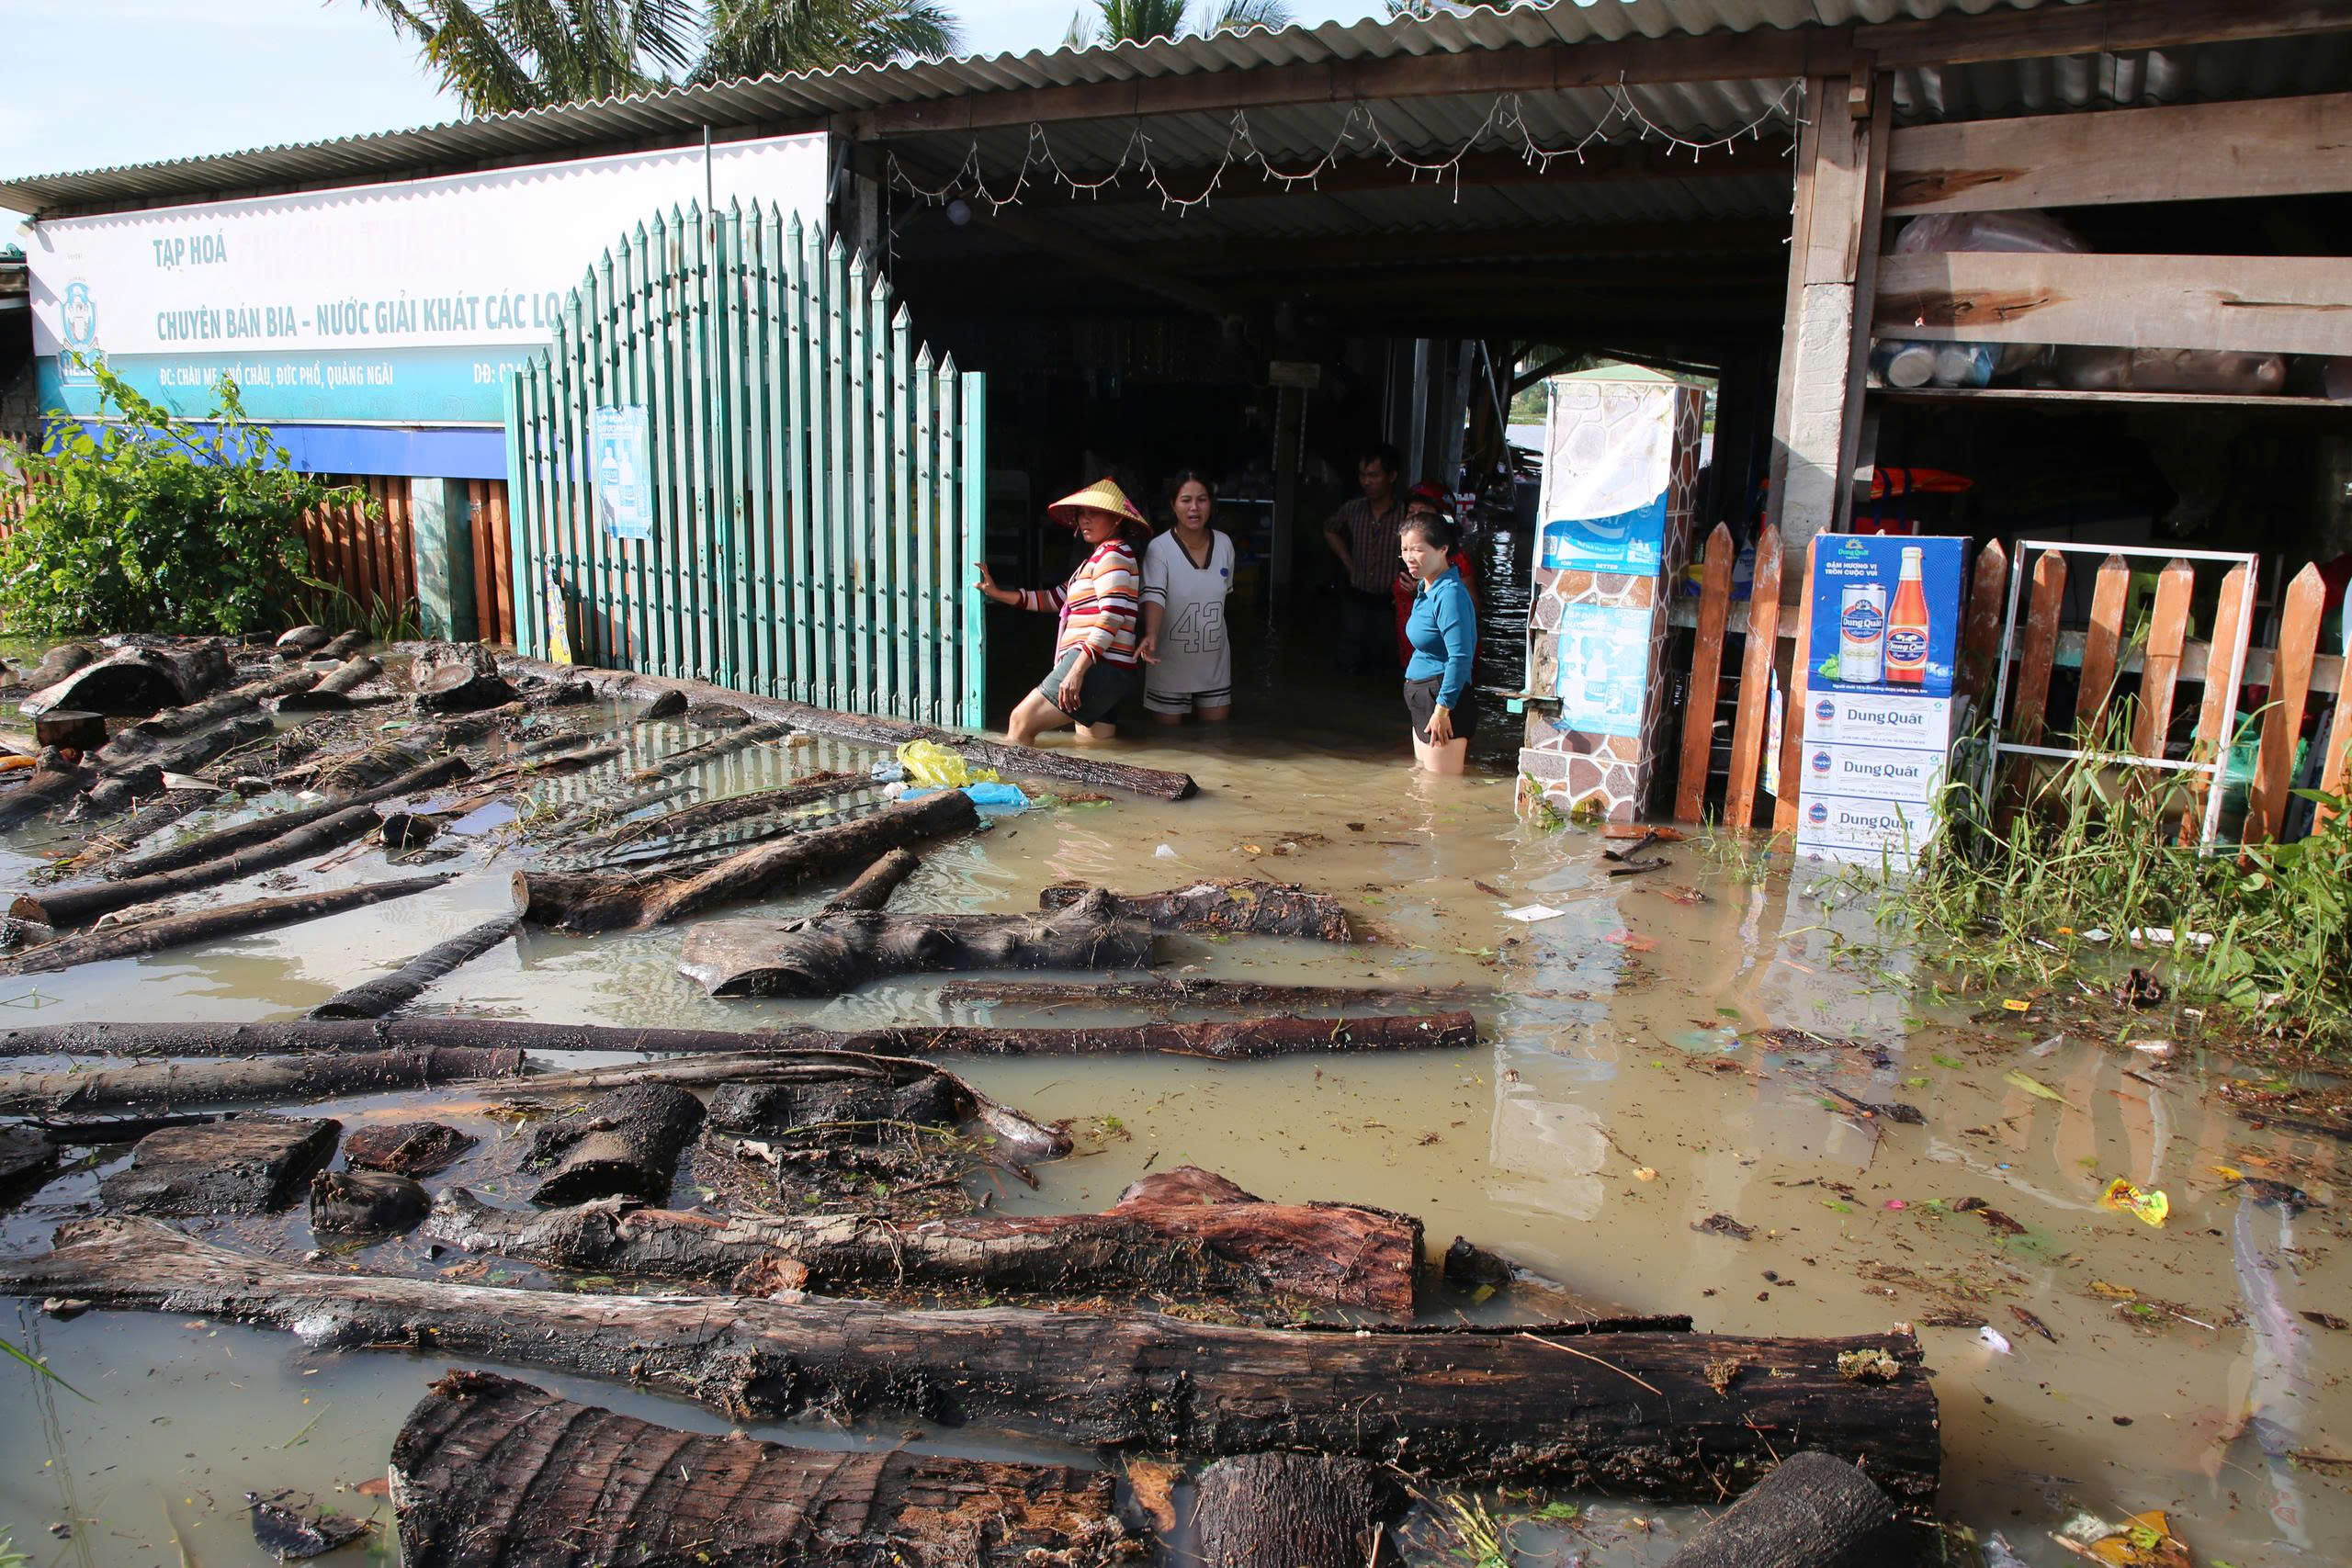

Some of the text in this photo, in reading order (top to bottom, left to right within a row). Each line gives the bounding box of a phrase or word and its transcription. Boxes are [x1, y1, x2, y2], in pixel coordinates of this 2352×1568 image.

[153, 228, 227, 271] TẠP HOÁ
[157, 304, 221, 341] CHUYÊN
[226, 299, 261, 338] BÁN
[266, 306, 297, 337] BIA
[317, 296, 369, 335] NƯỚC
[375, 289, 416, 334] GIẢI
[424, 289, 480, 332] KHÁT
[485, 288, 526, 329] CÁC
[160, 367, 175, 386] ĐC:
[176, 366, 200, 386] CHÂU
[277, 364, 297, 385] ĐỨC
[300, 360, 324, 389] PHỔ,
[327, 361, 363, 389] QUẢNG
[368, 363, 393, 385] NGÃI
[474, 364, 495, 383] DĐ:
[1838, 548, 1854, 557] Dung
[1844, 569, 1864, 577] CUỘC
[1170, 602, 1223, 653] 42
[1843, 618, 1863, 627] Dung
[1848, 709, 1885, 725] Dung
[1887, 712, 1923, 725] Quất
[1844, 761, 1882, 776] Dung
[1883, 764, 1918, 777] Quất
[1840, 813, 1878, 829] Dung
